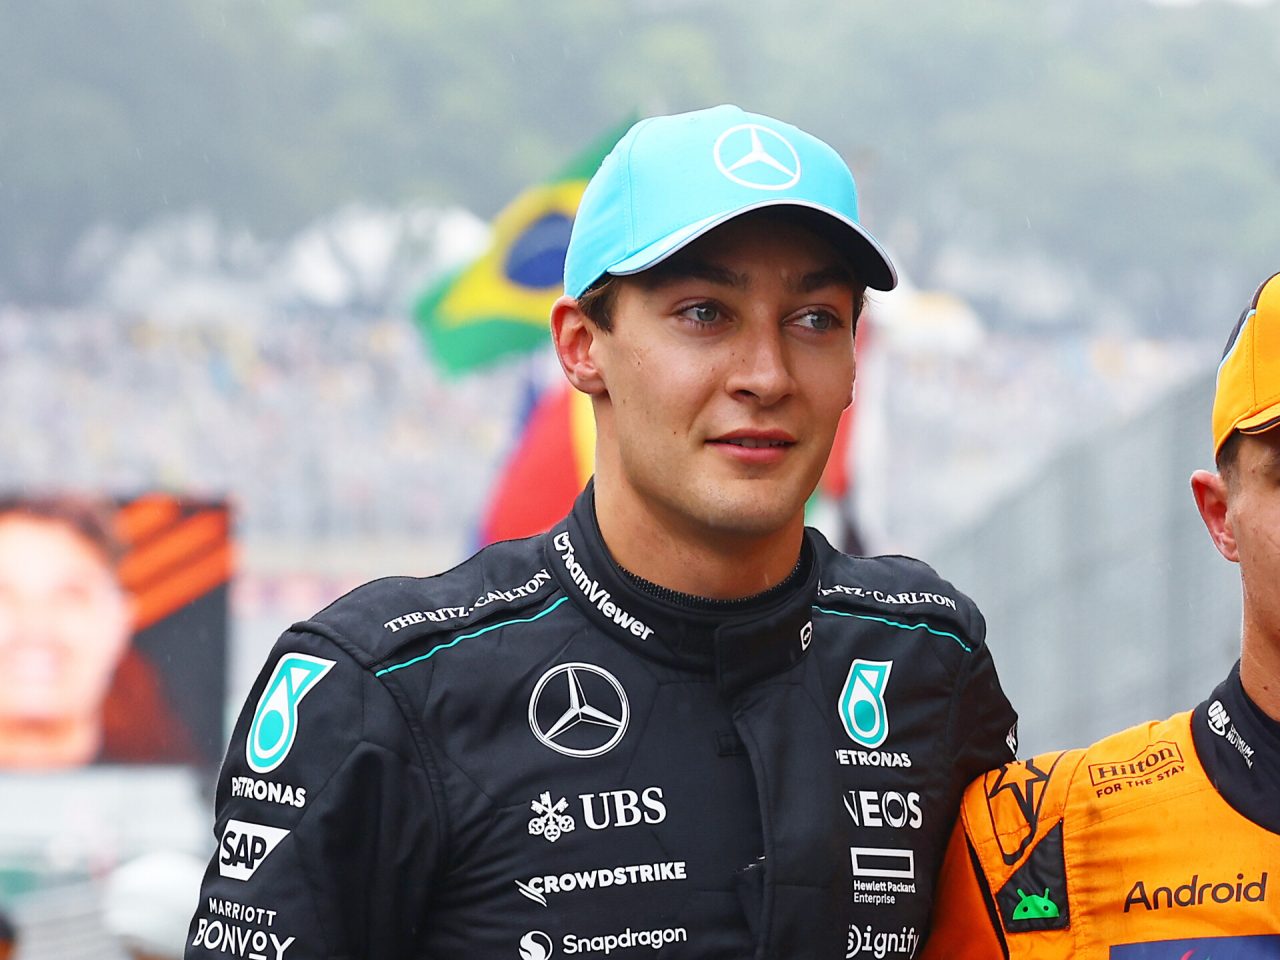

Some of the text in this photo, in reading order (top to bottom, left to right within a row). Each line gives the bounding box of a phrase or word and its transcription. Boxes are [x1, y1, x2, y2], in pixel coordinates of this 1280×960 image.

[562, 541, 655, 641] TeamViewer
[384, 611, 427, 633] THE
[836, 749, 912, 768] ETRONAS
[1098, 745, 1174, 781] Hilton
[231, 776, 307, 808] PETRONAS
[1096, 765, 1186, 799] FOR THE STAY
[578, 786, 667, 831] UBS
[843, 790, 923, 829] NEOS
[221, 830, 267, 870] SAP
[526, 861, 687, 896] CROWDSTRIKE
[853, 880, 916, 894] Hewlett Packard
[1123, 872, 1268, 913] Android
[208, 897, 277, 926] MARRIOTT
[853, 892, 896, 906] Enterprise
[562, 927, 688, 955] Snapdragon
